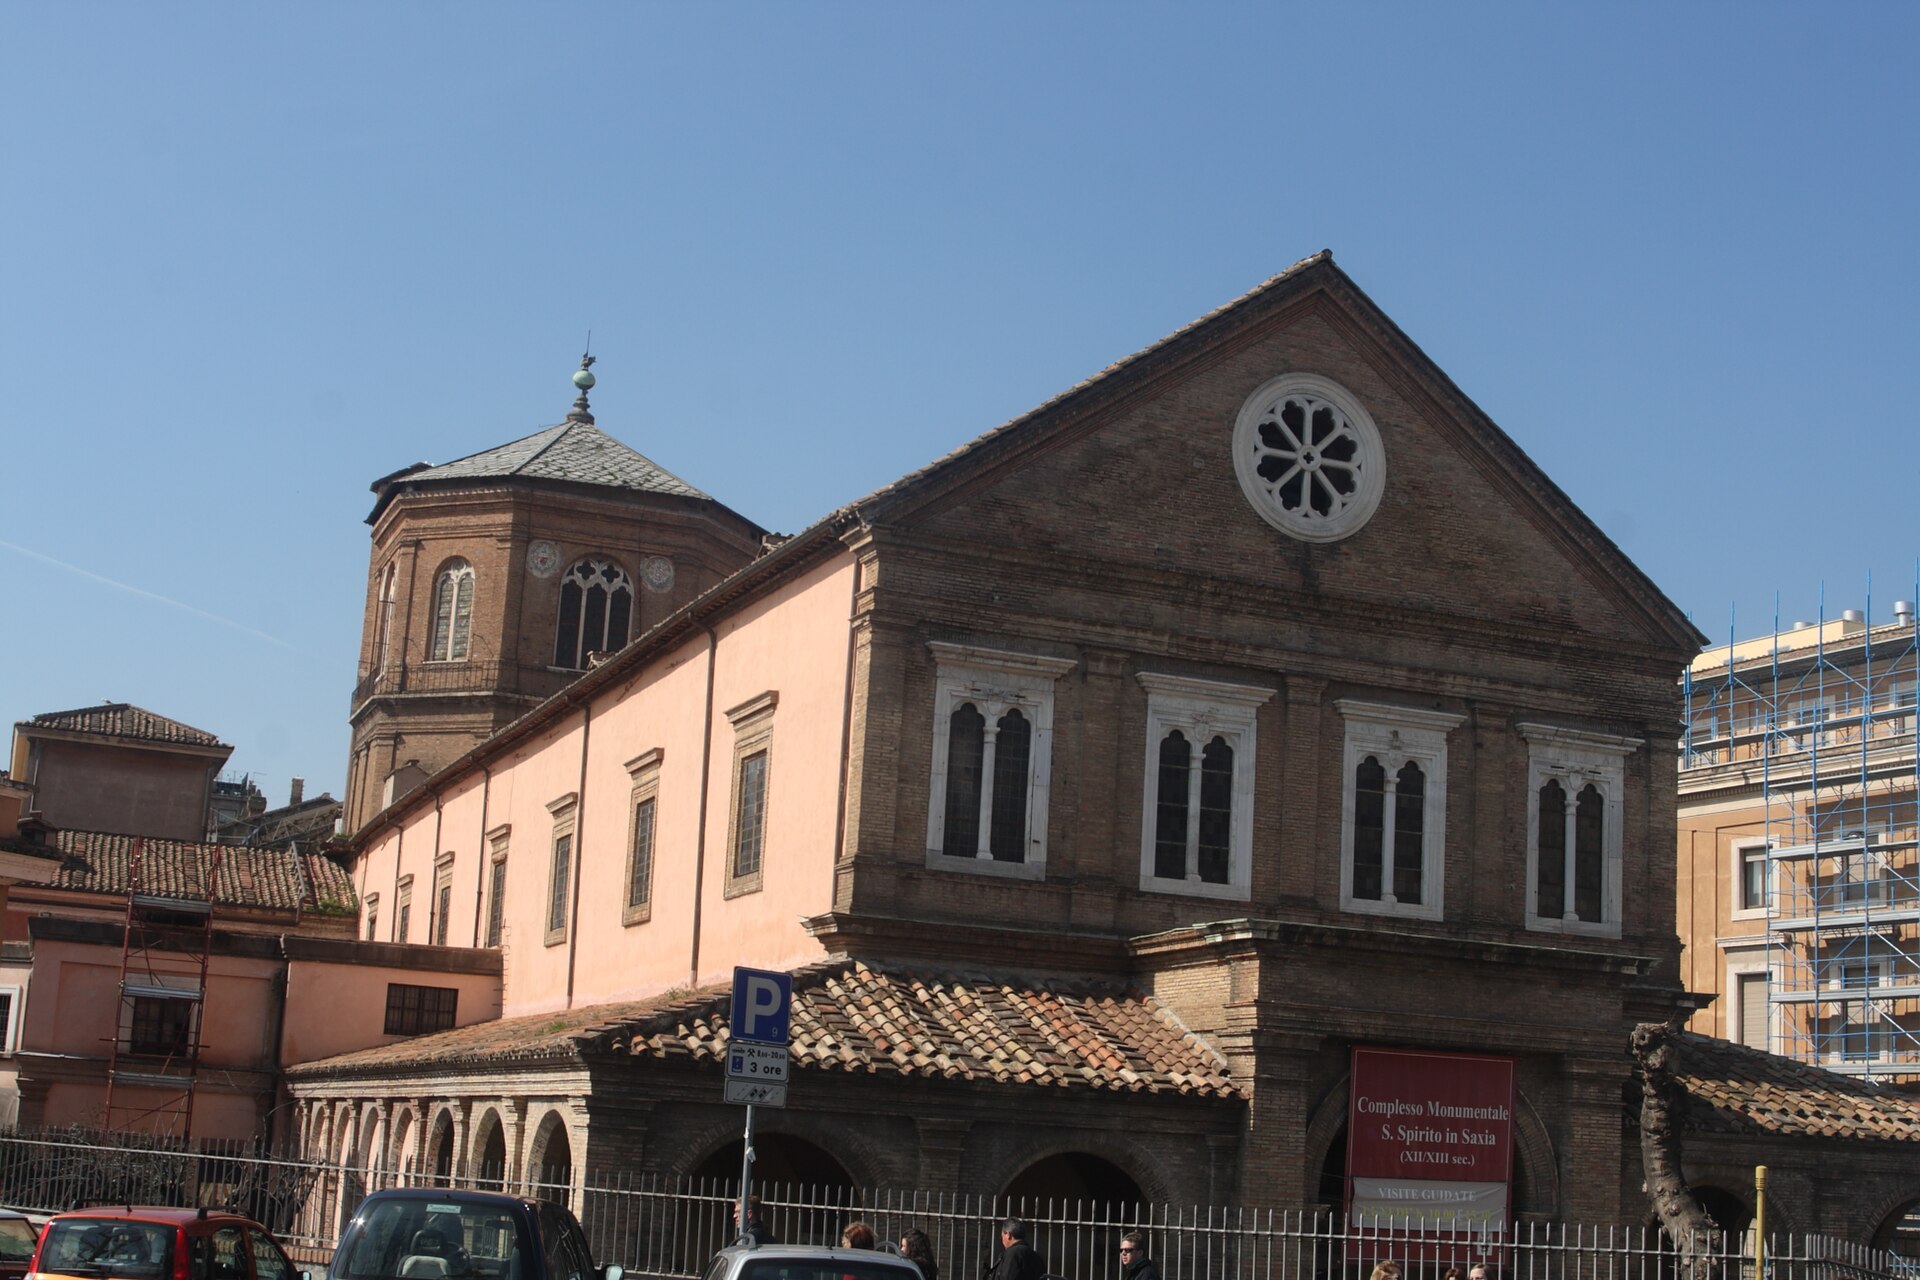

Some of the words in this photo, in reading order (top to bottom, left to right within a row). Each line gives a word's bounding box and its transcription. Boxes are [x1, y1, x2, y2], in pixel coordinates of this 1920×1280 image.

[744, 976, 782, 1034] P
[771, 1026, 778, 1037] 9
[750, 1062, 758, 1073] 3
[763, 1067, 782, 1075] ore
[1357, 1096, 1423, 1118] Complesso
[1427, 1100, 1509, 1121] Monumentale
[1381, 1123, 1394, 1140] S.
[1397, 1124, 1442, 1145] Spirito
[1446, 1128, 1458, 1144] in
[1461, 1128, 1497, 1145] Saxia
[1400, 1150, 1449, 1164] (XII/XIII
[1452, 1155, 1475, 1166] sec.)
[1378, 1188, 1419, 1200] VISITE
[1421, 1188, 1477, 1202] GUIDATE
